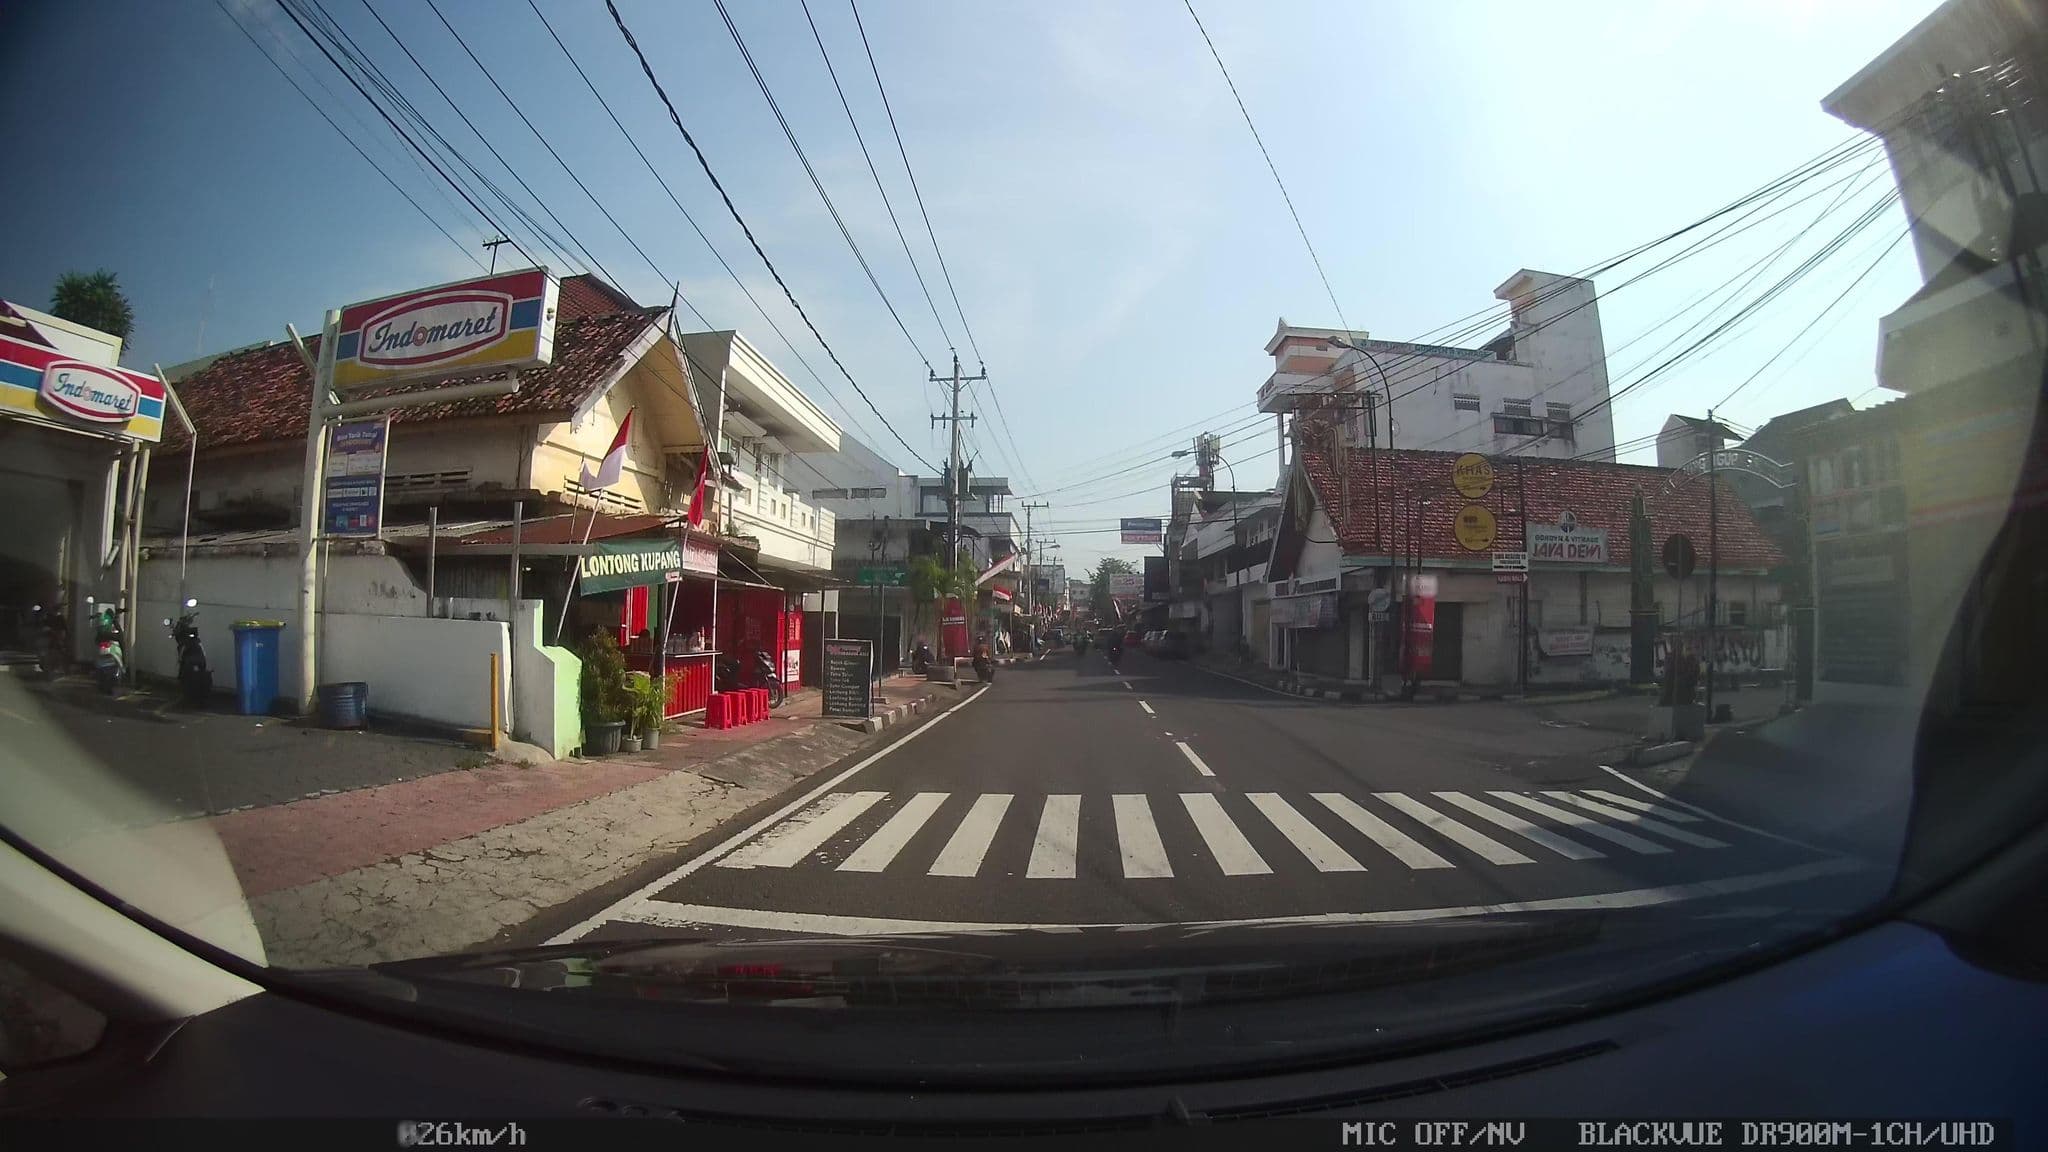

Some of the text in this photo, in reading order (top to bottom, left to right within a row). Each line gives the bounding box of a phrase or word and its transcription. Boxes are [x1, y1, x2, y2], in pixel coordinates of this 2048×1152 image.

[368, 307, 498, 352] Indomaret
[53, 373, 132, 411] Indomaret
[581, 554, 639, 578] LONTONG
[641, 550, 681, 572] KUPANG
[1567, 544, 1601, 560] DEWI
